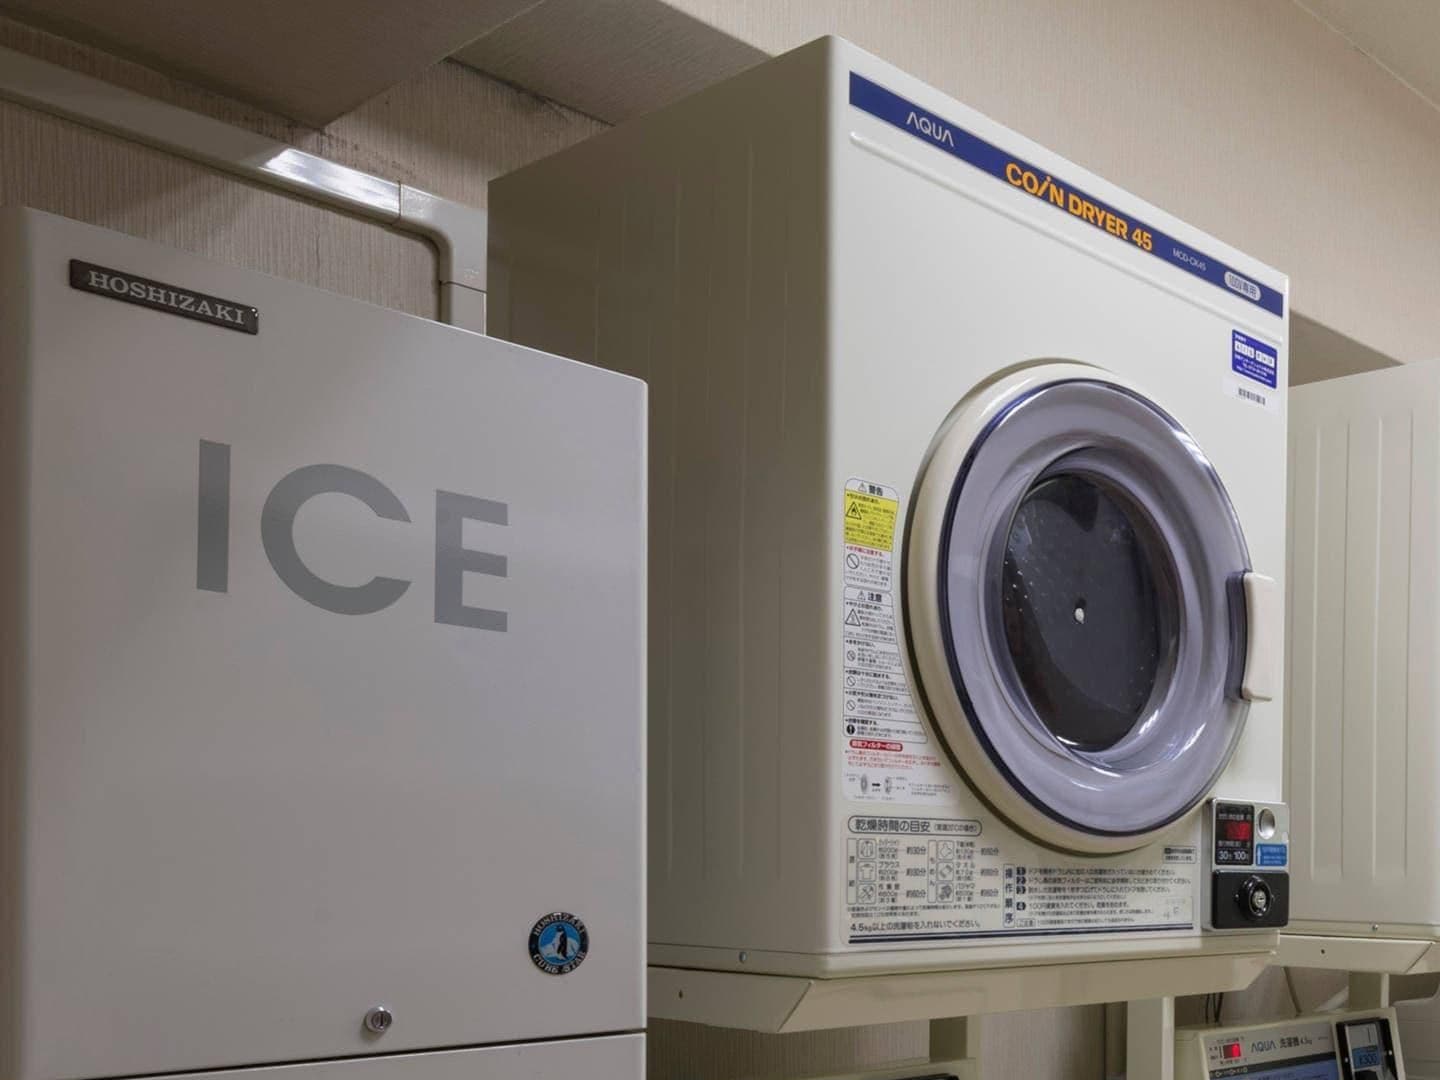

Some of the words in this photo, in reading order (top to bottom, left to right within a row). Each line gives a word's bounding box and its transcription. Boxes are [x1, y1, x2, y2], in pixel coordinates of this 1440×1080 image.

[906, 111, 954, 148] AQUA
[1006, 163, 1064, 207] COIN
[1069, 192, 1128, 240] DRYER
[1132, 229, 1153, 252] 45
[89, 270, 245, 325] HOSHIZAKI
[197, 439, 508, 632] ICE
[855, 819, 930, 832] 乾燥時間の目安
[1251, 1040, 1276, 1053] AQUA
